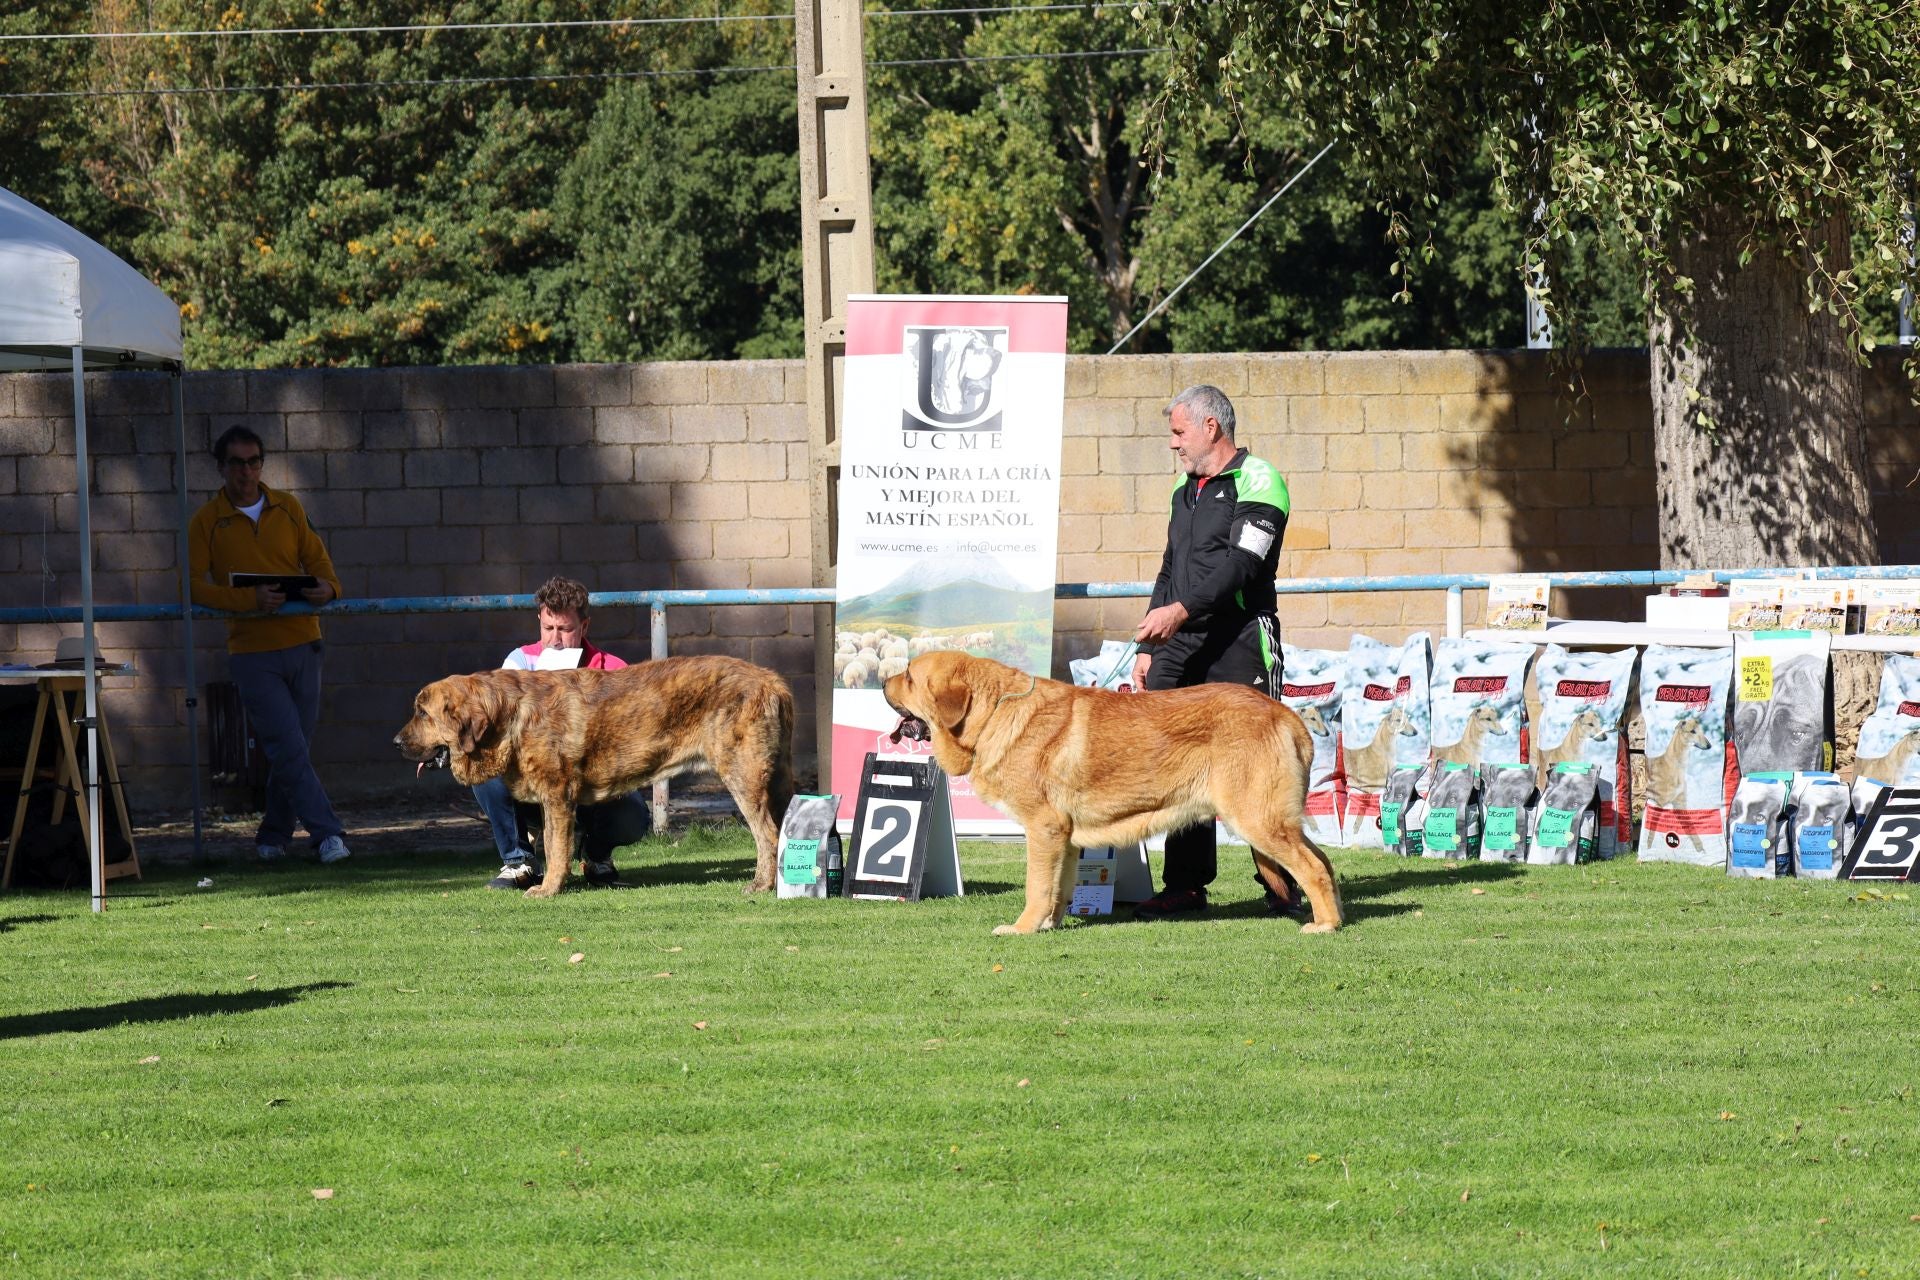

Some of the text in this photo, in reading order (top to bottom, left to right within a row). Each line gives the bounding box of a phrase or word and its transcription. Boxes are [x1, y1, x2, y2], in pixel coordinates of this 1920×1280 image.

[903, 432, 1003, 450] UCME
[851, 463, 1052, 481] UNIÓN PARA LA CRÍA
[881, 489, 1021, 507] Y MEJORA DEL
[865, 510, 1034, 526] MASTÍN ESPAÑOL
[860, 541, 1037, 554] www.ucme.es info@ucme.es
[1659, 687, 1709, 701] VELOX PLUS
[1488, 810, 1514, 818] titanium
[1736, 827, 1765, 836] titanium
[863, 805, 911, 877] 2
[1864, 817, 1920, 864] 3
